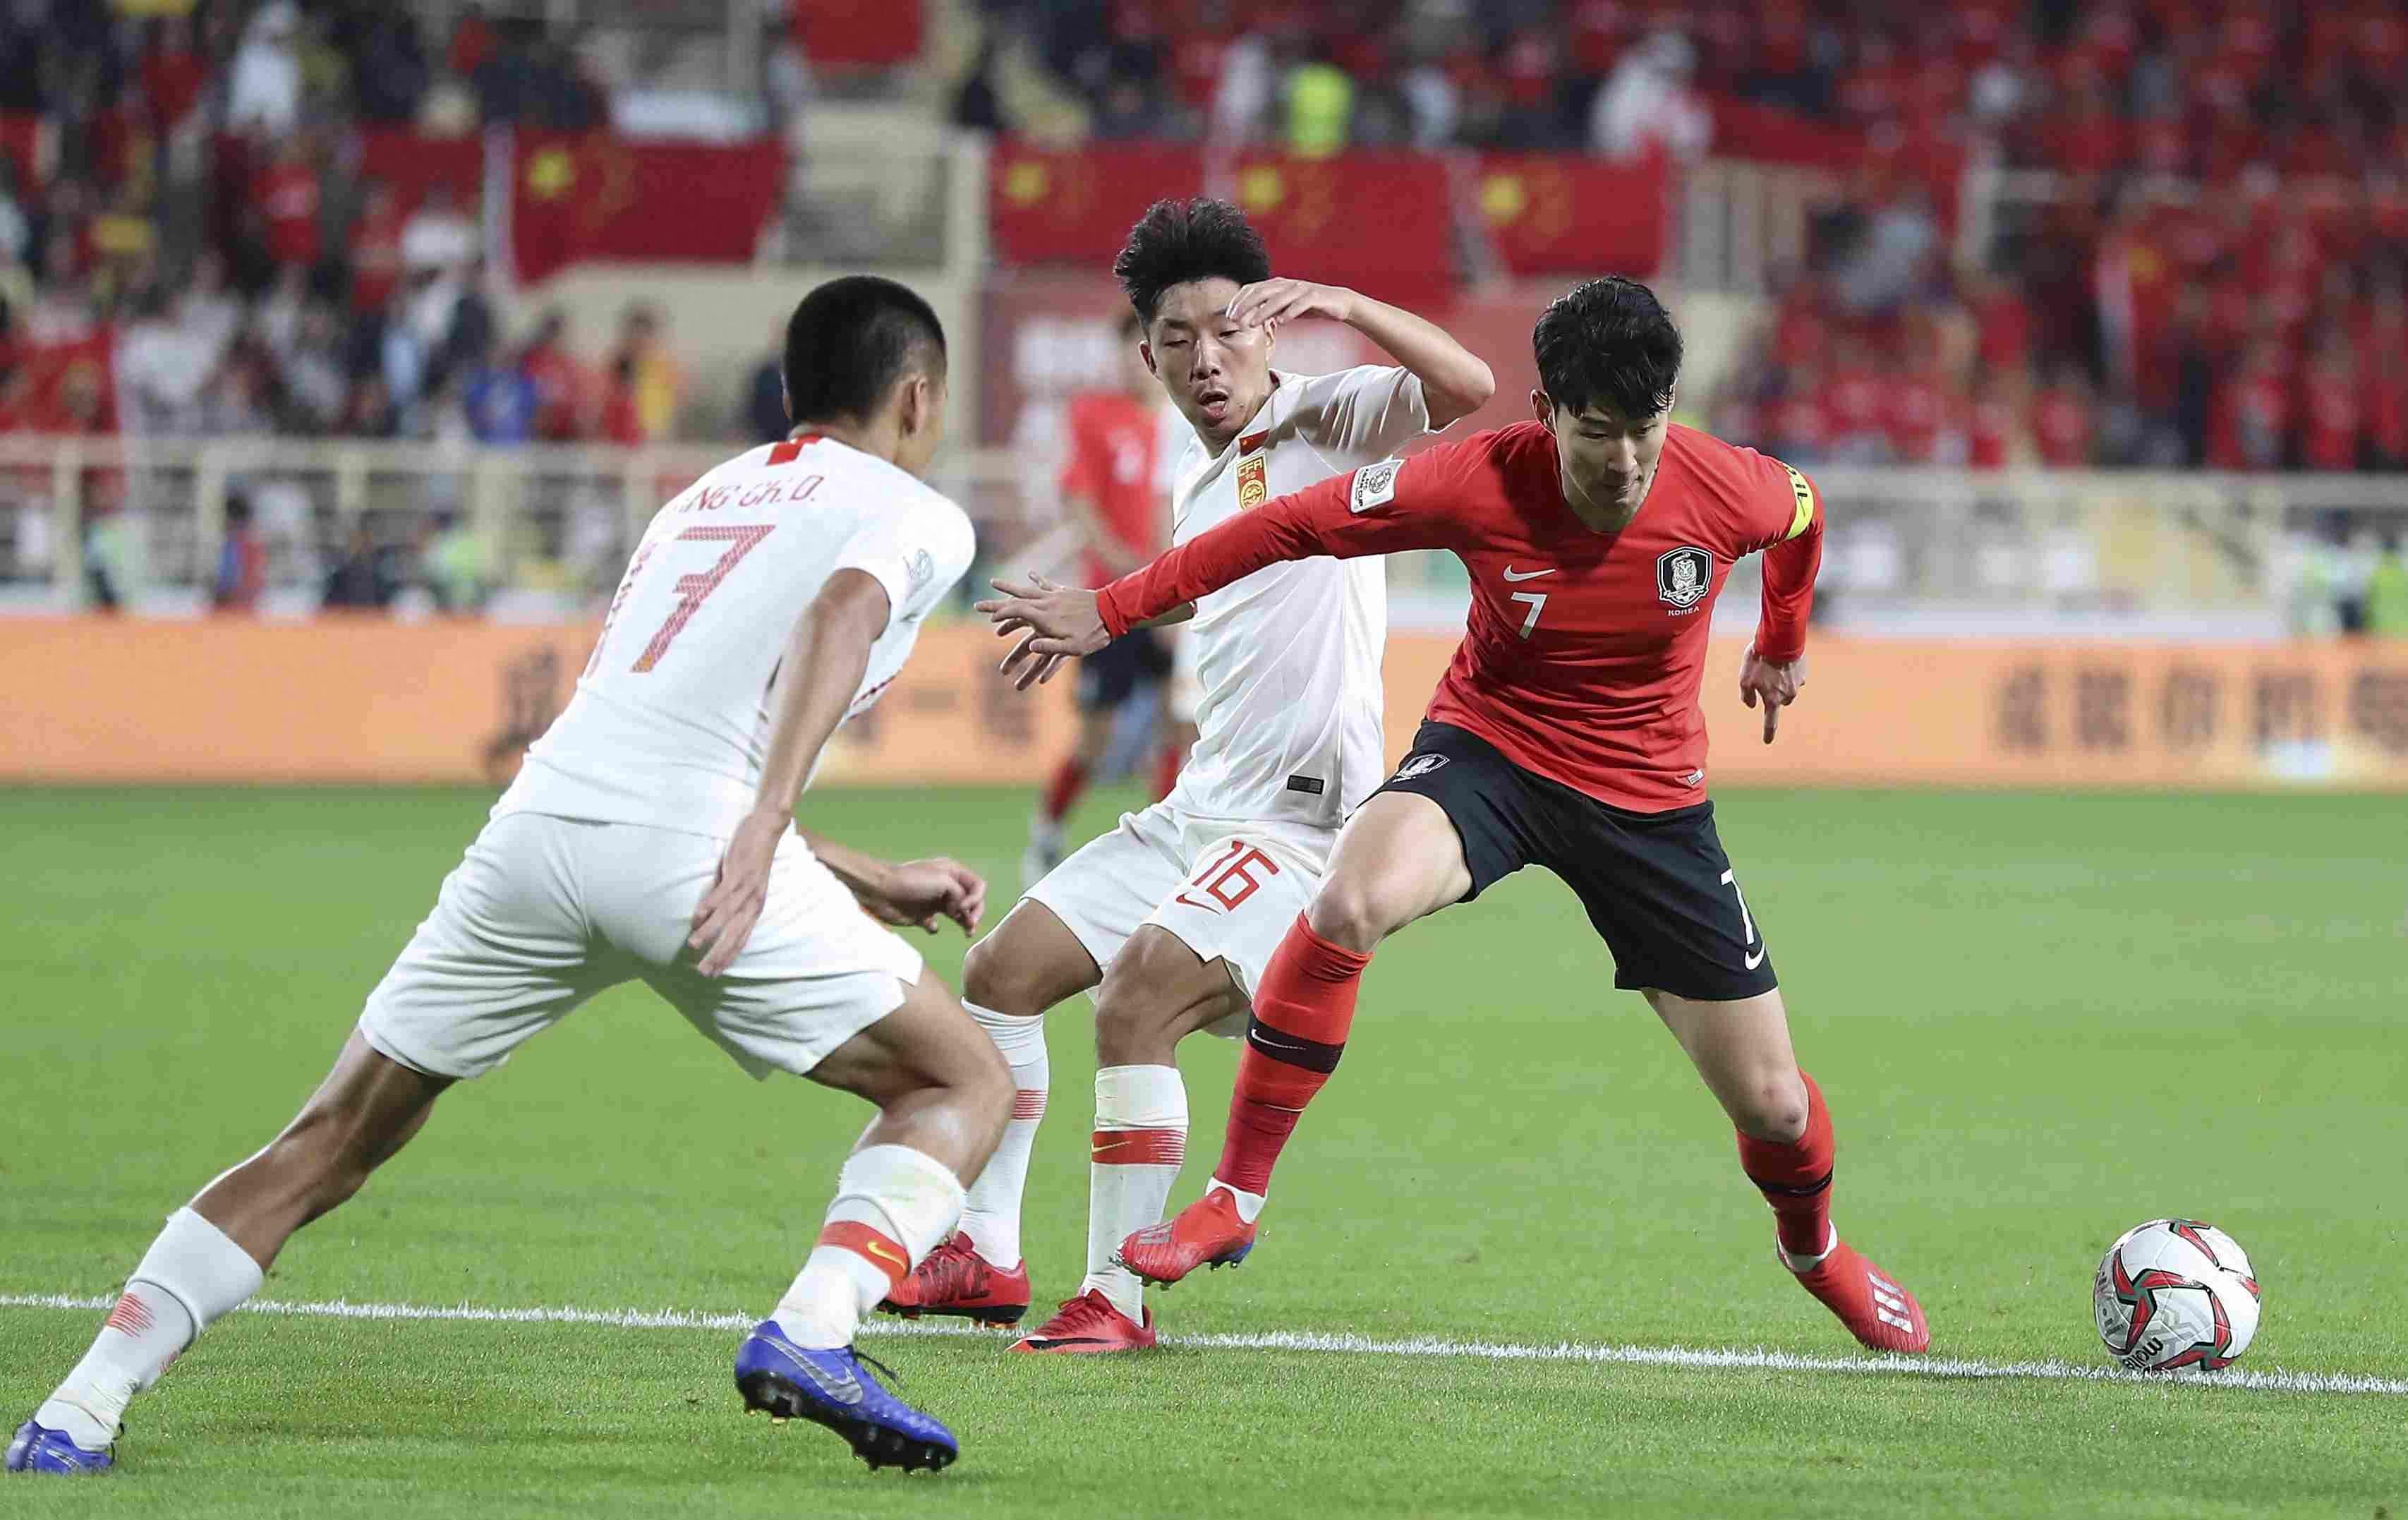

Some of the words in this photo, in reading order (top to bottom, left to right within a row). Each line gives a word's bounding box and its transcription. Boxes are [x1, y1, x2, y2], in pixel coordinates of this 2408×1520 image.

[1510, 591, 1547, 639] 7
[1667, 605, 1700, 617] KOREA
[1192, 840, 1280, 912] 16
